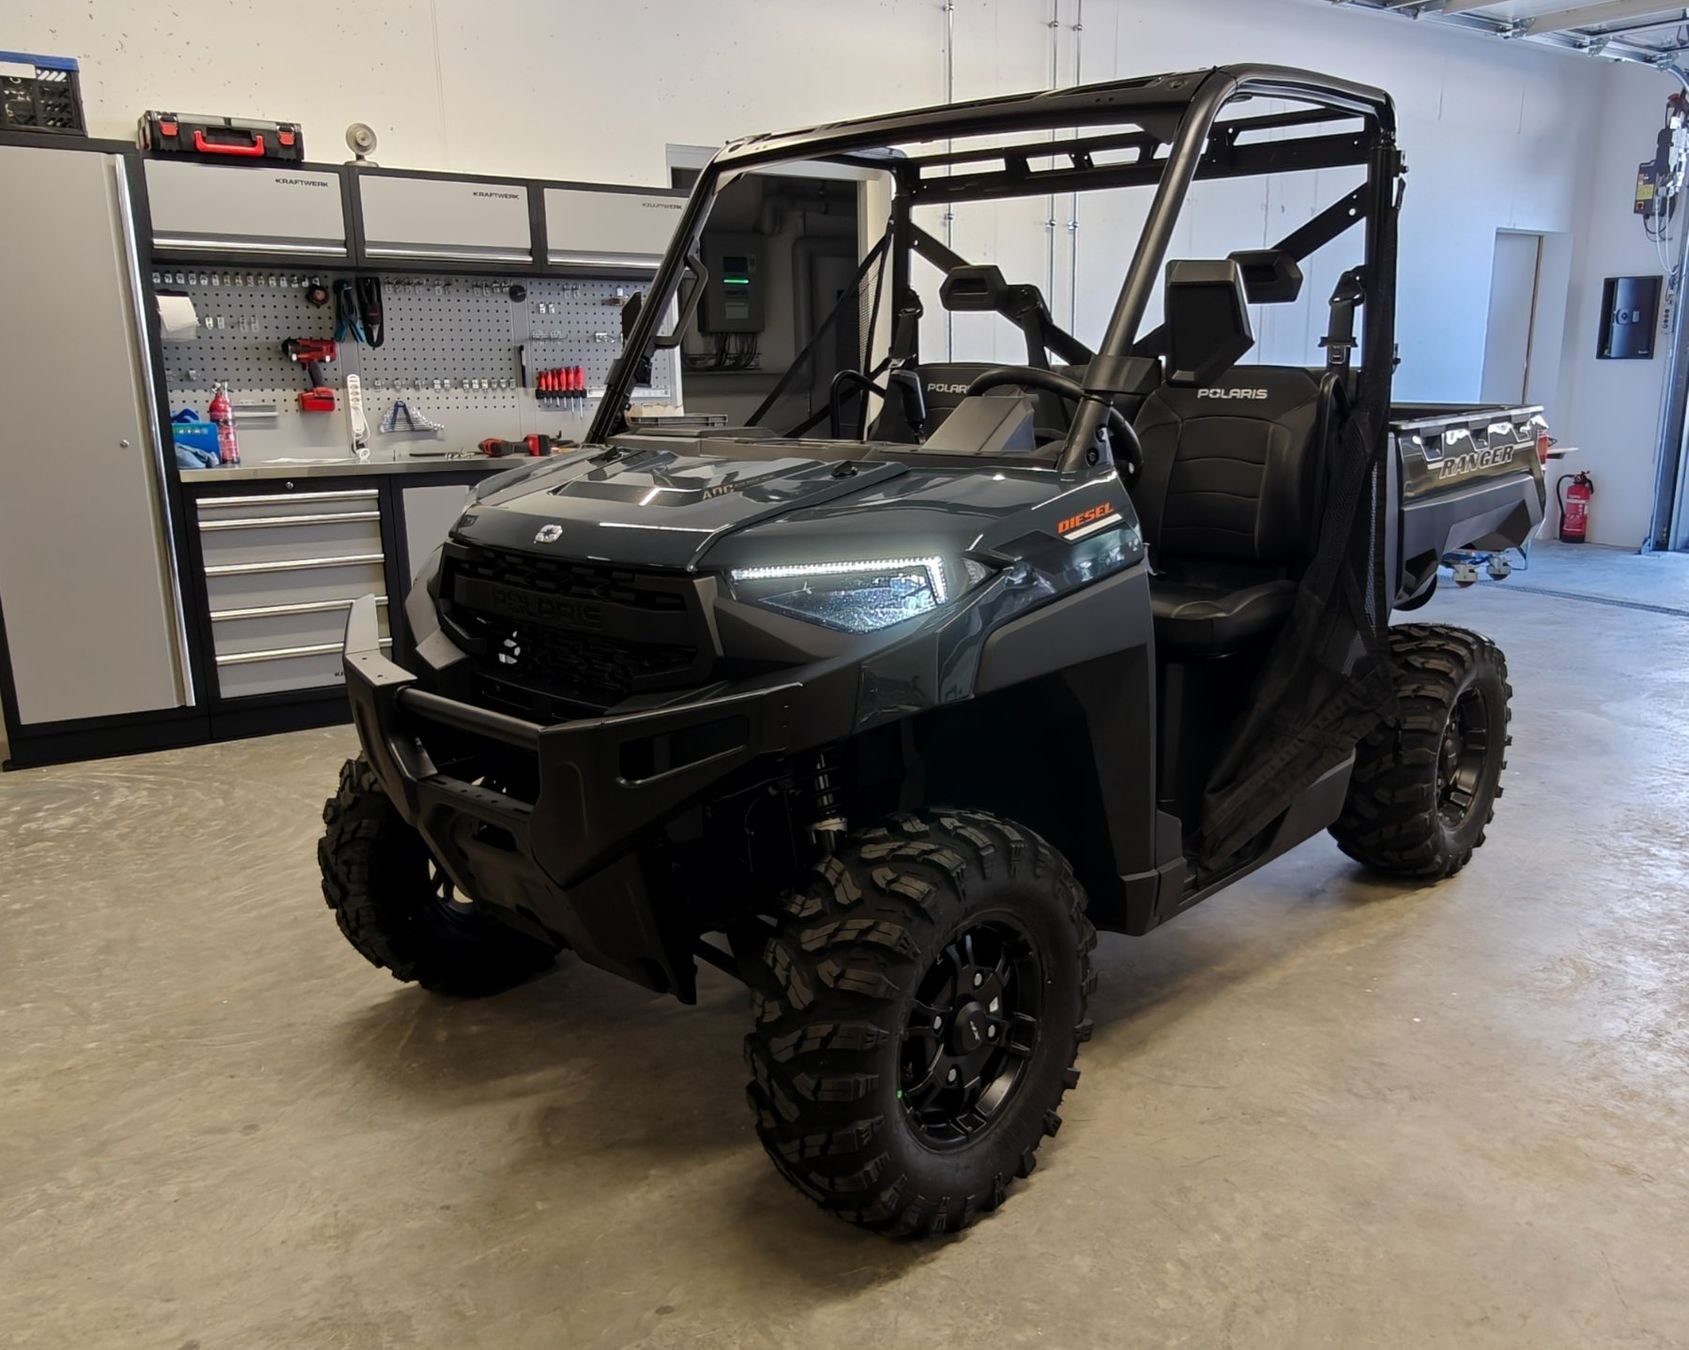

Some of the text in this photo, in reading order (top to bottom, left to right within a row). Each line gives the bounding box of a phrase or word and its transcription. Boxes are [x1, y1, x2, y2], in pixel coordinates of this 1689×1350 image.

[275, 178, 328, 187] KRAFTWERK
[927, 383, 970, 394] POLAR
[1197, 388, 1268, 399] POLARIS
[1439, 444, 1514, 480] RANGER
[1058, 501, 1114, 534] DIESEL
